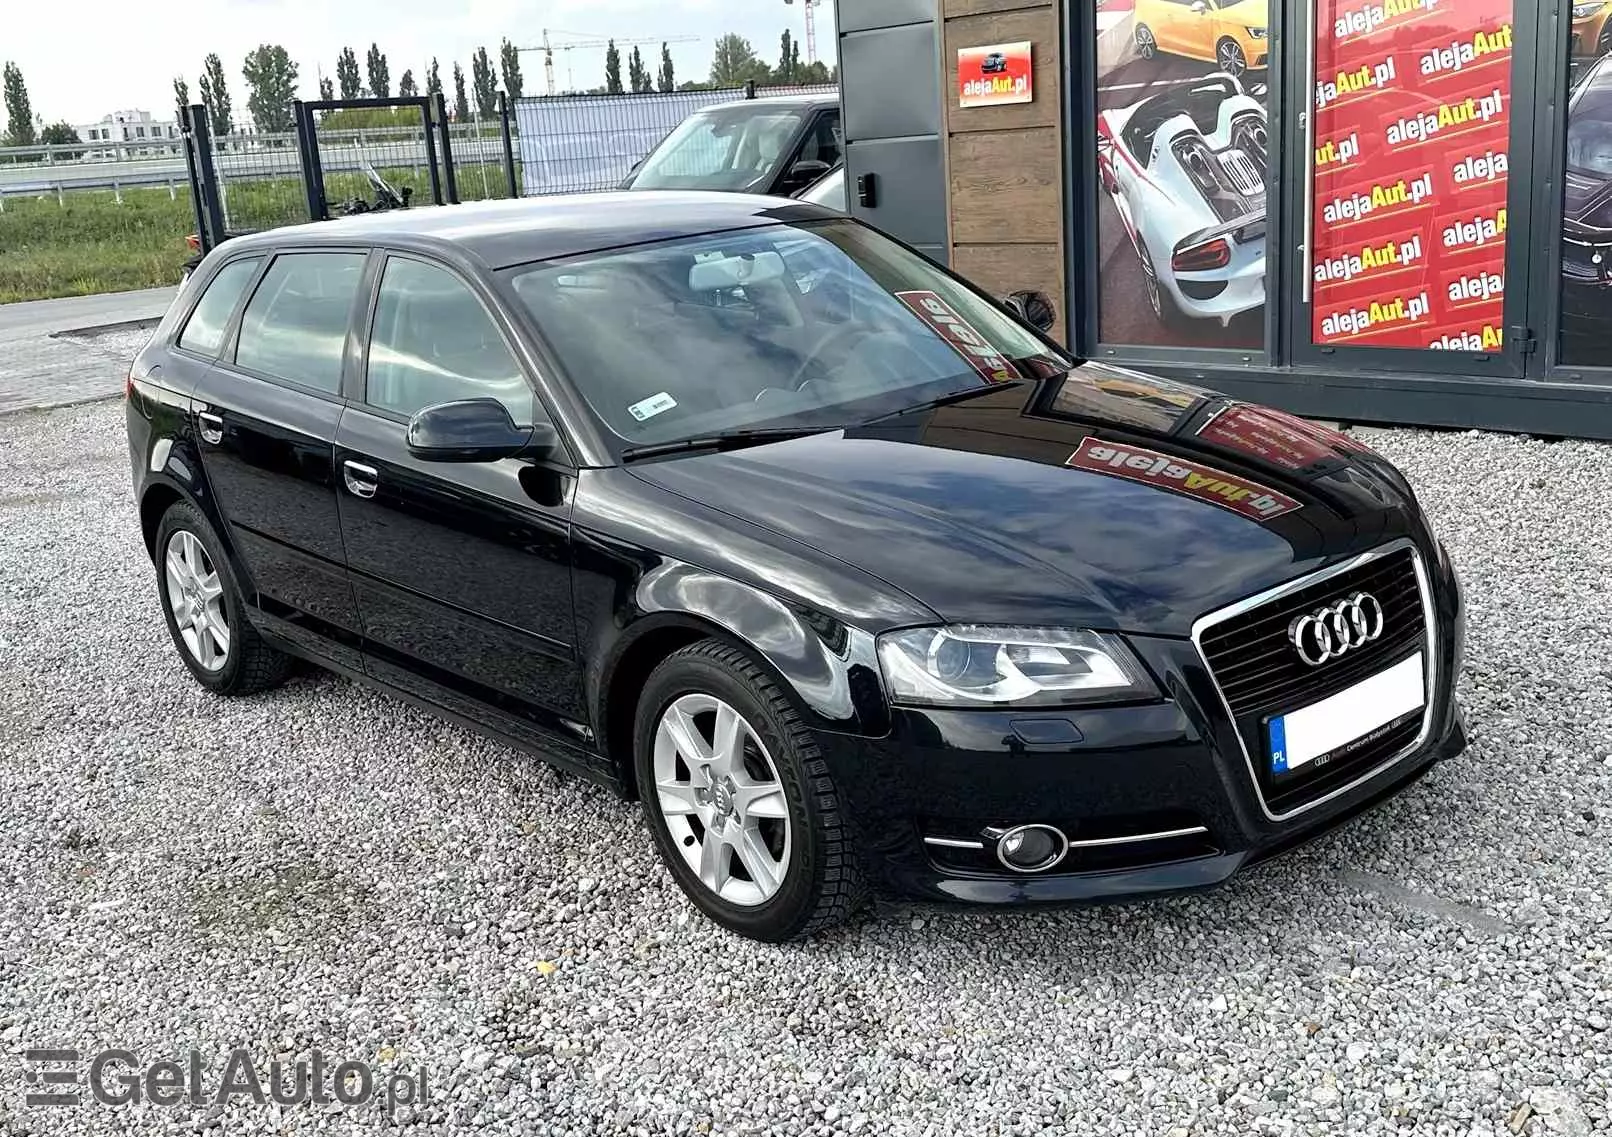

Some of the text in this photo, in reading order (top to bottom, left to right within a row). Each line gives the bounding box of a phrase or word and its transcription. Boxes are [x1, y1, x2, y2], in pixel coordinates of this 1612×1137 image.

[963, 74, 1027, 96] alejaAut.pl
[1386, 89, 1503, 145] alejaAut.pl
[1323, 173, 1433, 223] alejaAut.pl
[1314, 235, 1422, 282] alejaAut.pl
[1321, 292, 1430, 336] alejaAut.pl
[1273, 751, 1285, 764] PL
